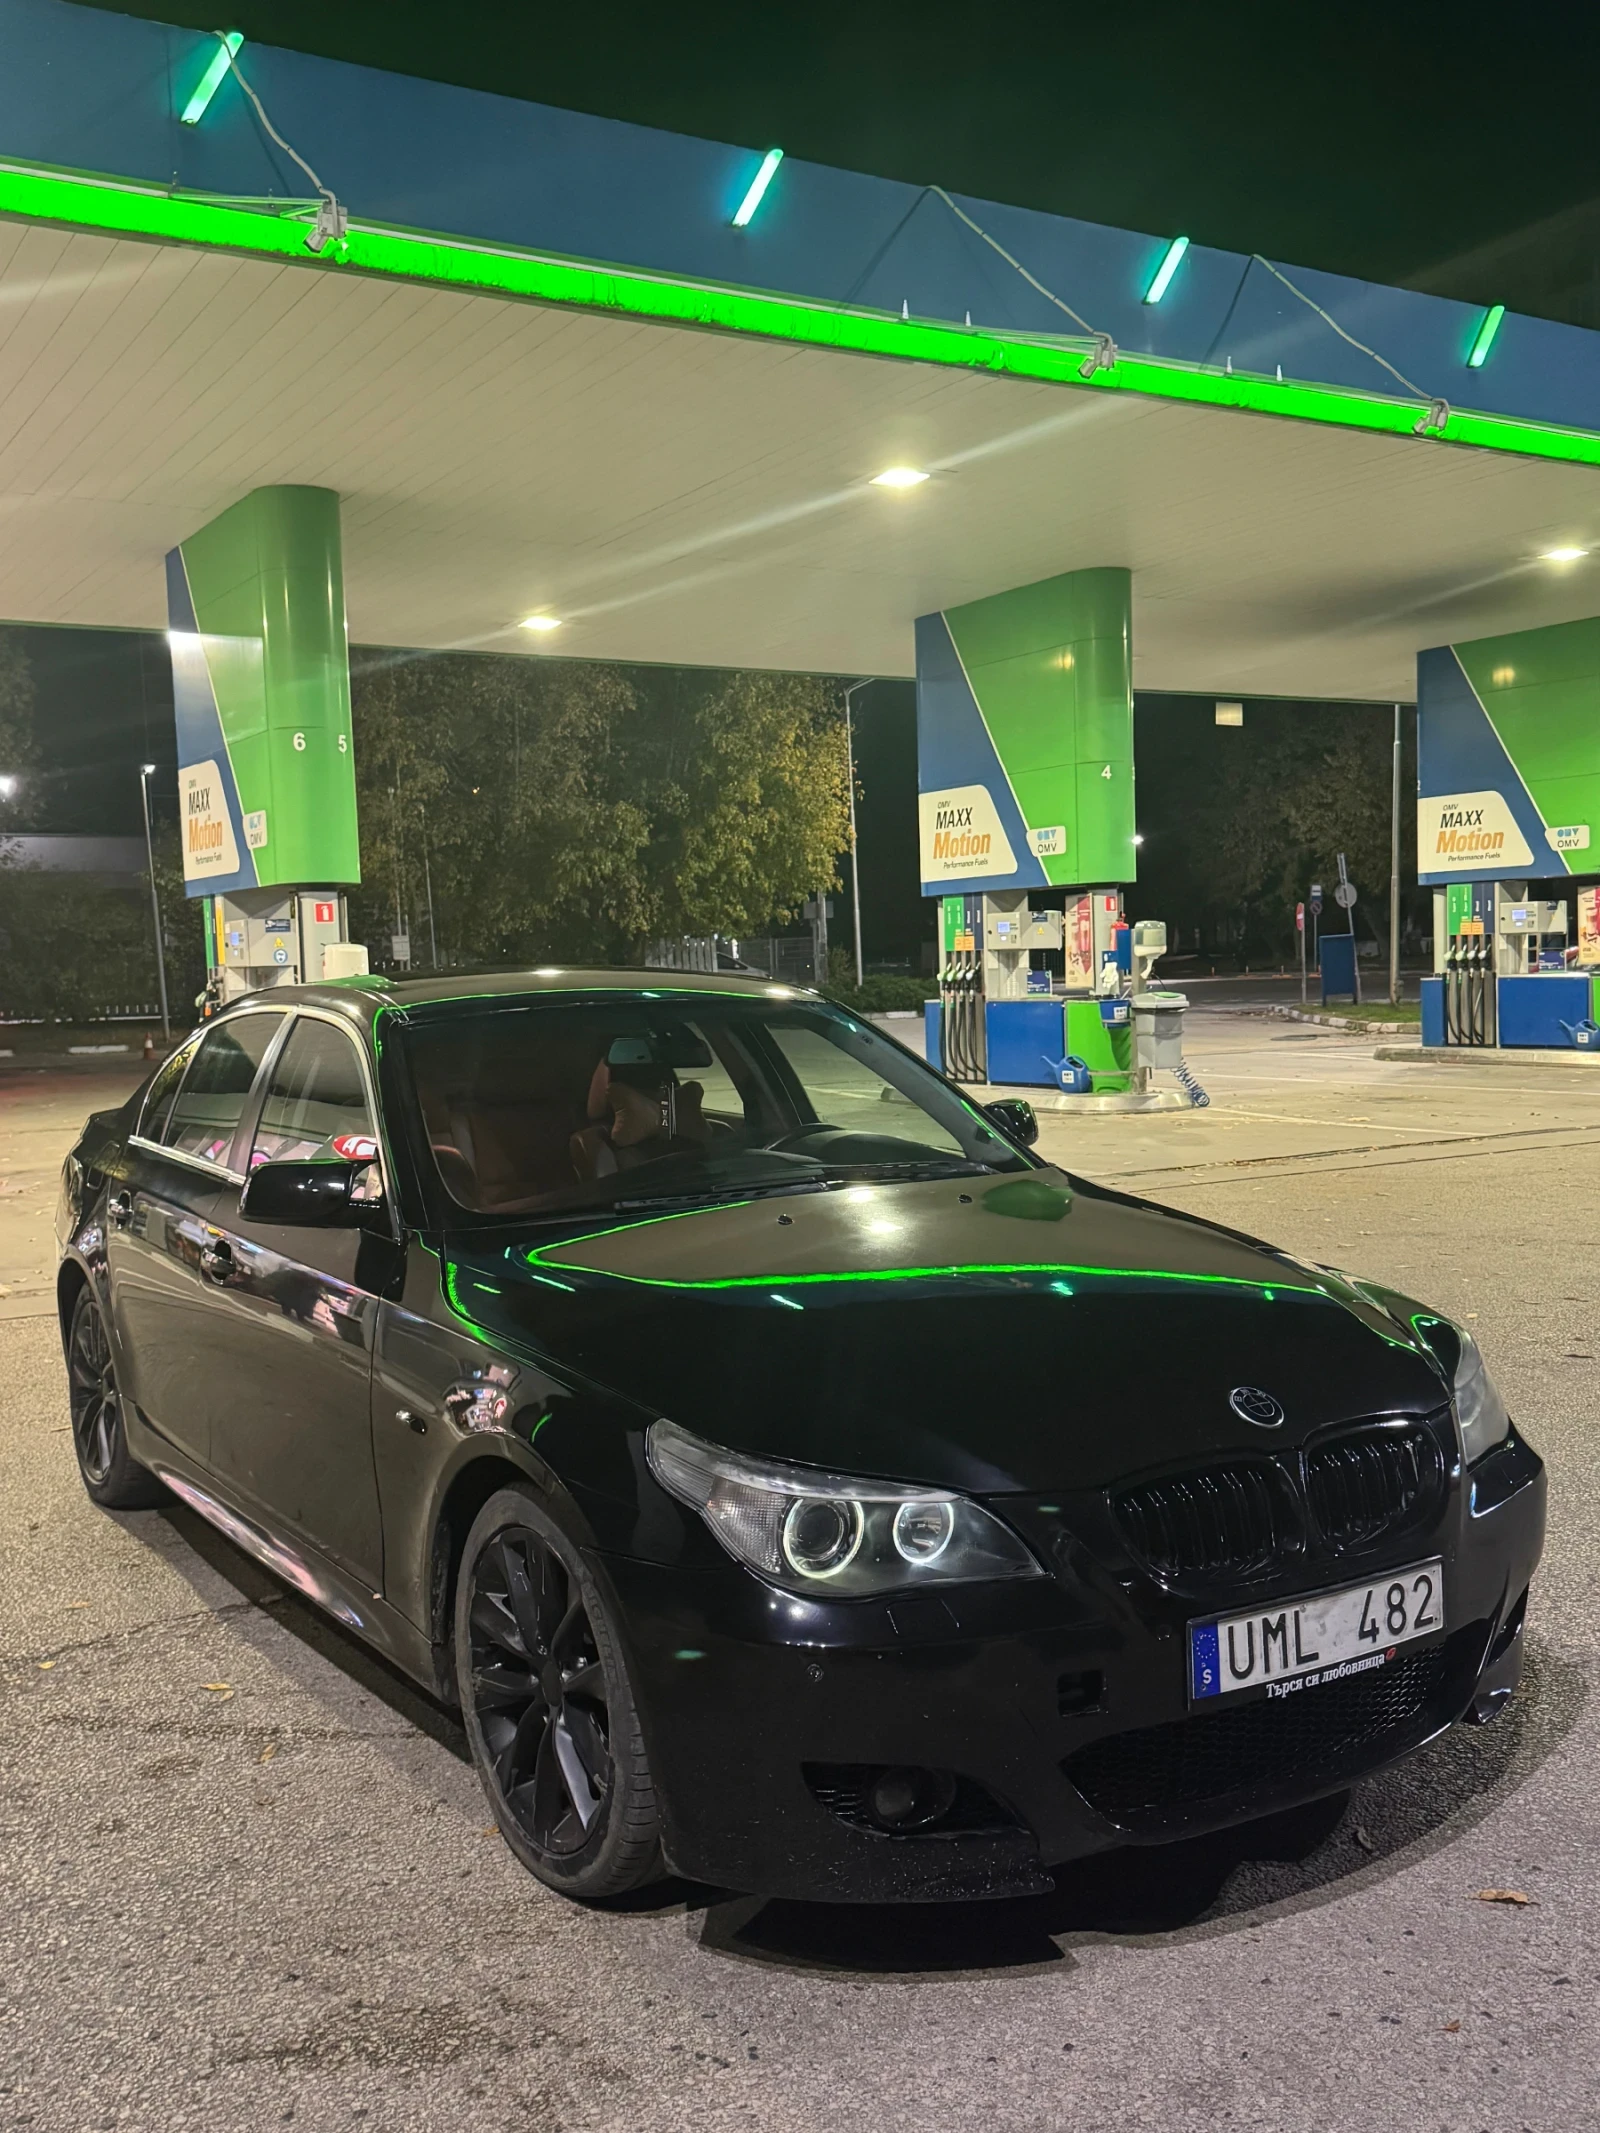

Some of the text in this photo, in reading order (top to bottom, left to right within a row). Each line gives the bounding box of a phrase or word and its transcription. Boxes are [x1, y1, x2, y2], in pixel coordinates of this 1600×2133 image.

[293, 732, 306, 751] 6
[338, 734, 347, 753] 5
[1101, 764, 1112, 779] 4
[188, 787, 210, 815] MAXX
[937, 800, 951, 809] OMV
[1443, 803, 1459, 811] OMV
[935, 807, 973, 830] MAXX
[1440, 809, 1484, 829] MAXX
[189, 814, 223, 852] Motion
[1435, 827, 1505, 853] Motion
[933, 829, 991, 859] Motion
[1037, 843, 1057, 853] OMV
[1557, 839, 1580, 848] OMV
[943, 858, 989, 869] Performance Fuels
[1447, 854, 1484, 862] Performance
[1228, 1574, 1434, 1680] UML 482
[1202, 1668, 1212, 1684] S
[1265, 1653, 1386, 1698] Търся си любовница
